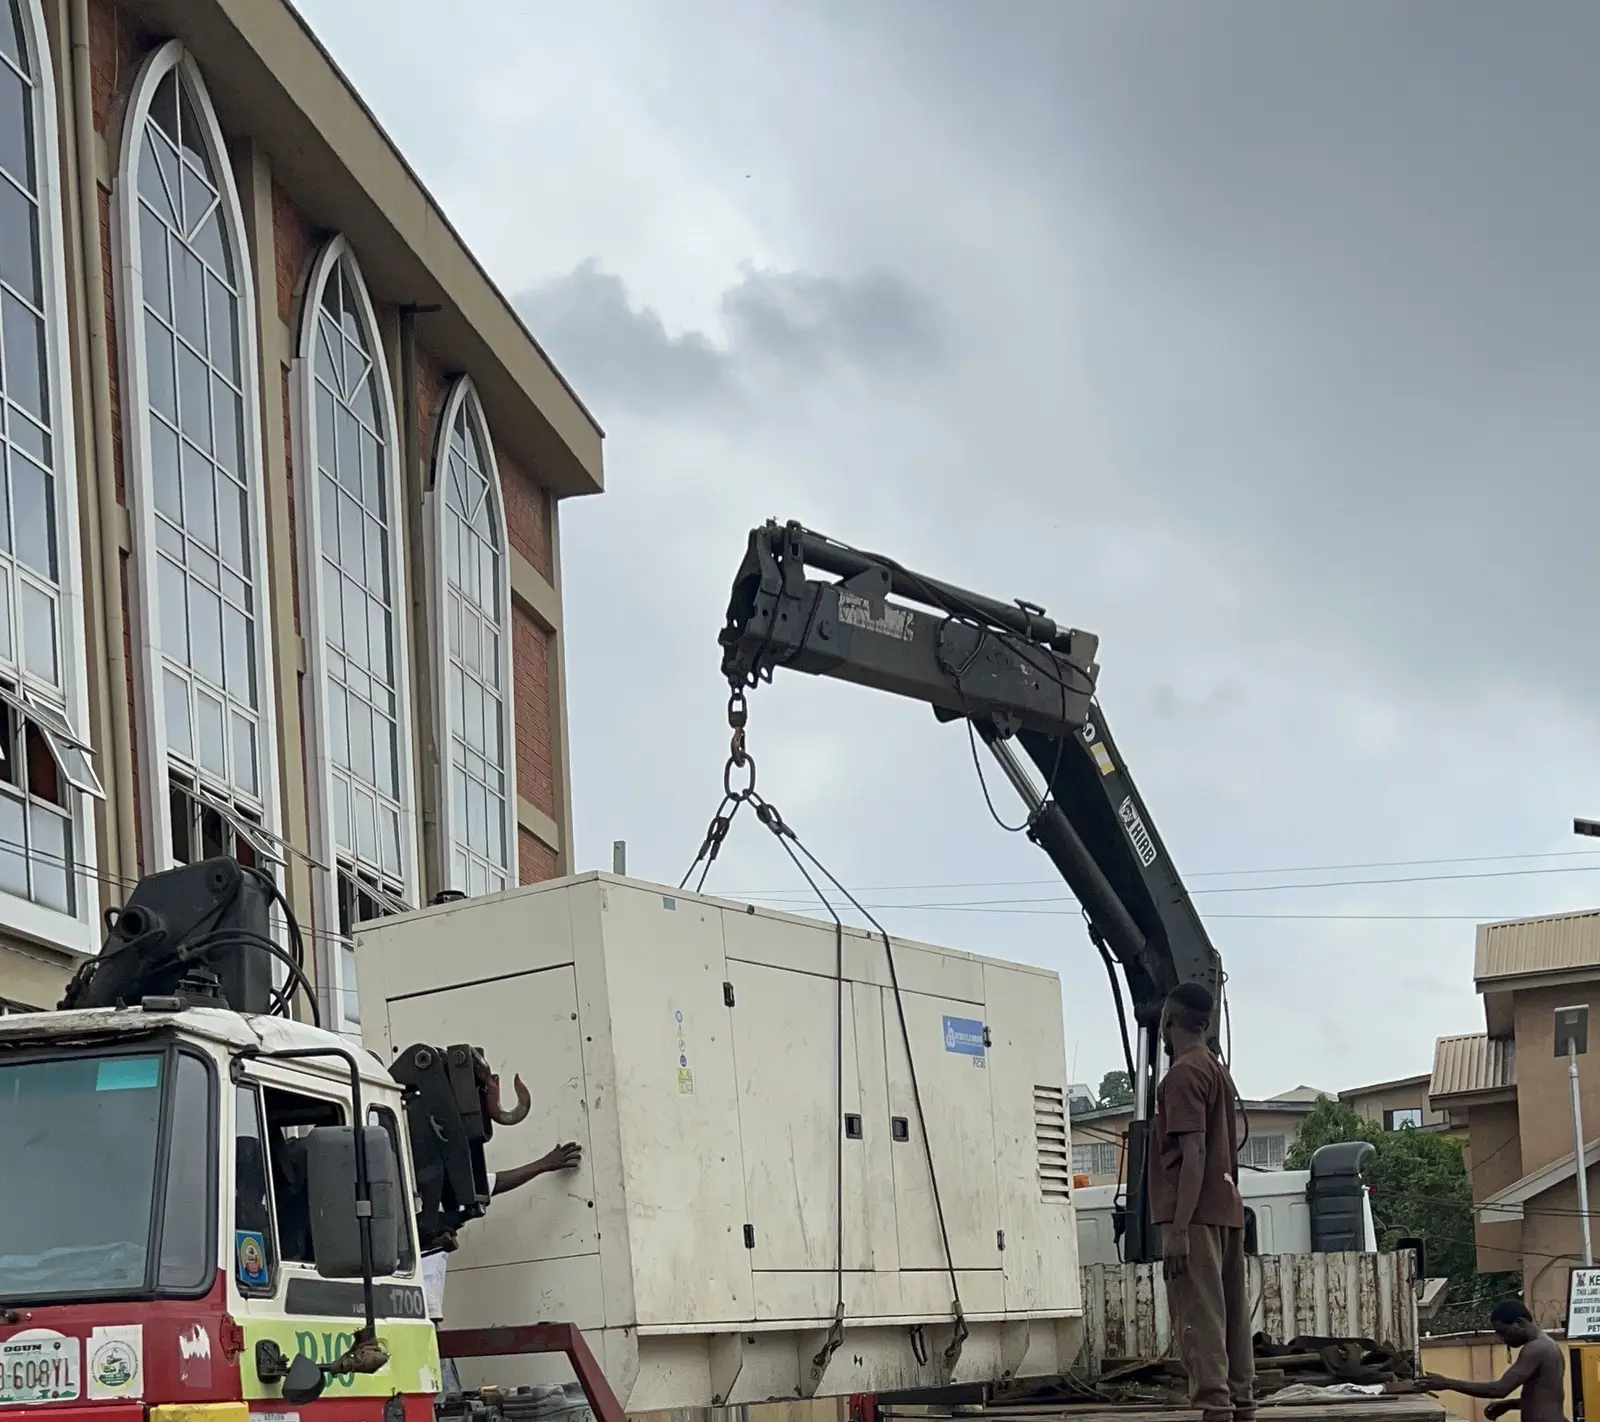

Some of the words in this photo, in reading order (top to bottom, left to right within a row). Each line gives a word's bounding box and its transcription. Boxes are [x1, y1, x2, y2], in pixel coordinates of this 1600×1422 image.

[1131, 822, 1155, 864] HIAB
[390, 1289, 423, 1315] 1700
[4, 1344, 42, 1352] OGUN
